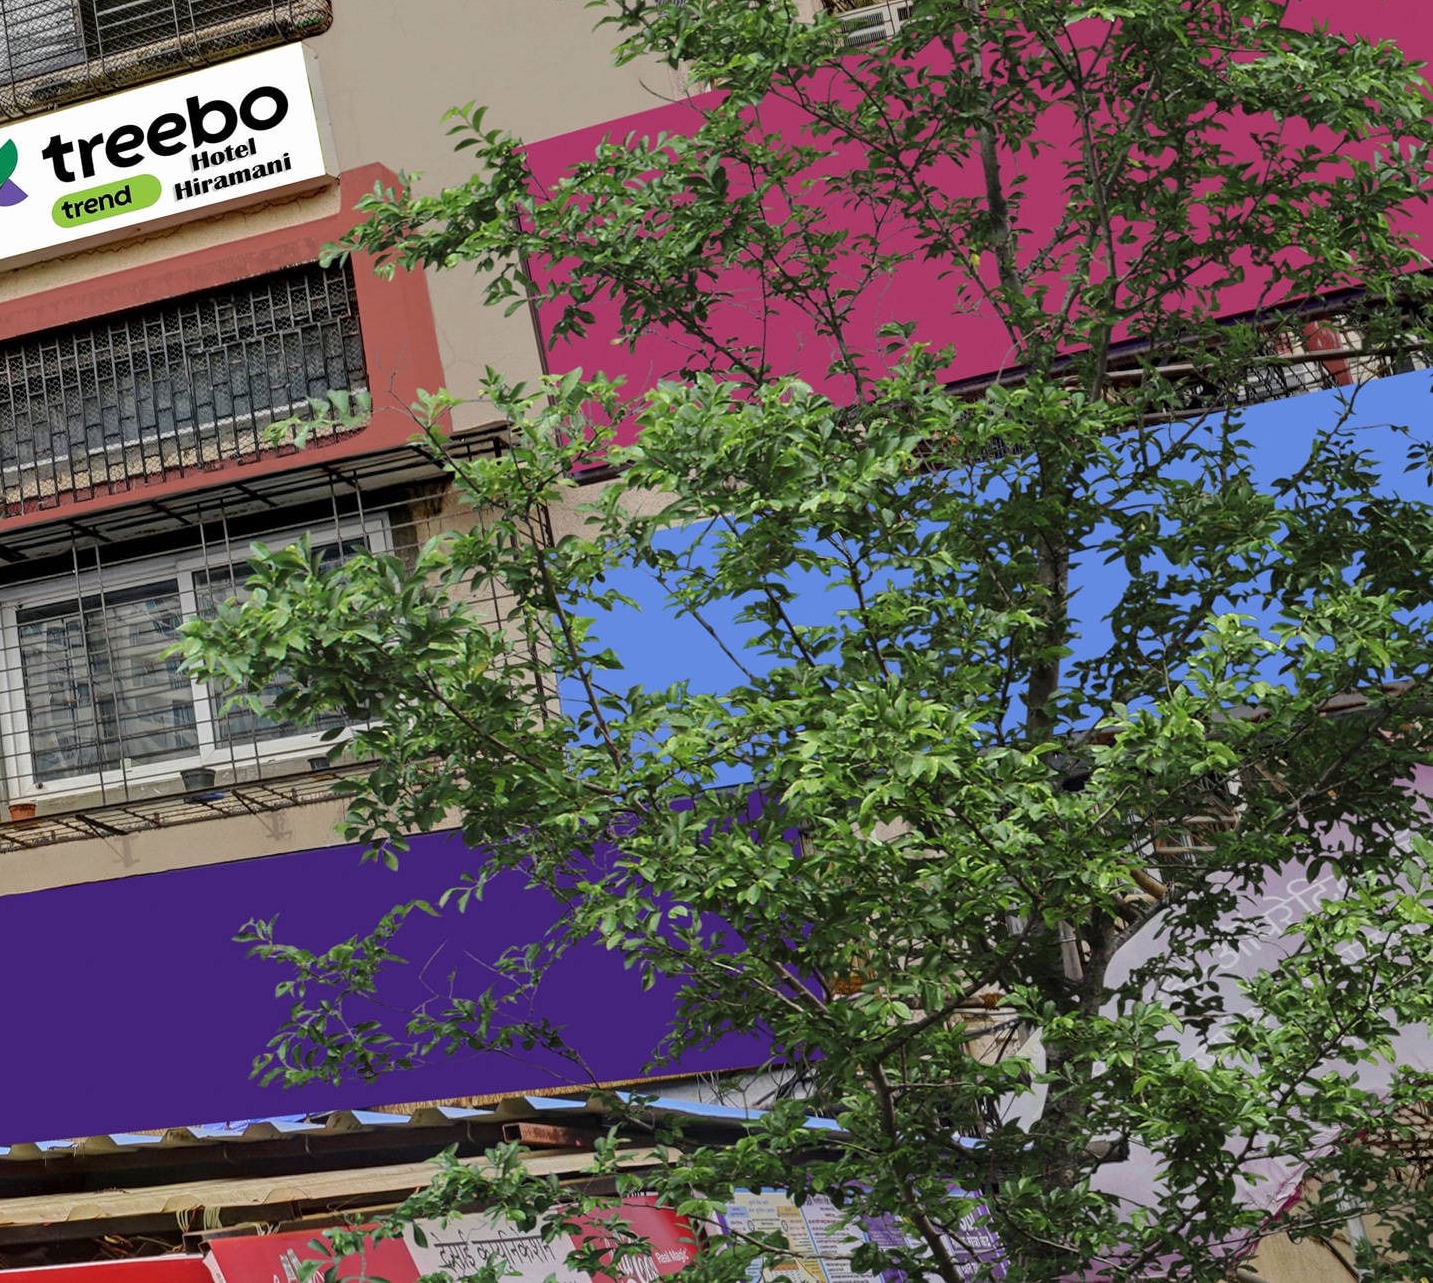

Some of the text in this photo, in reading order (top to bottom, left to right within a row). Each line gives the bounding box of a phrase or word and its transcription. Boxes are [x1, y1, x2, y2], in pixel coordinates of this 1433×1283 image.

[41, 85, 289, 183] treebo
[191, 137, 258, 172] Hotel
[174, 152, 293, 201] Hiramani
[60, 184, 133, 220] trend
